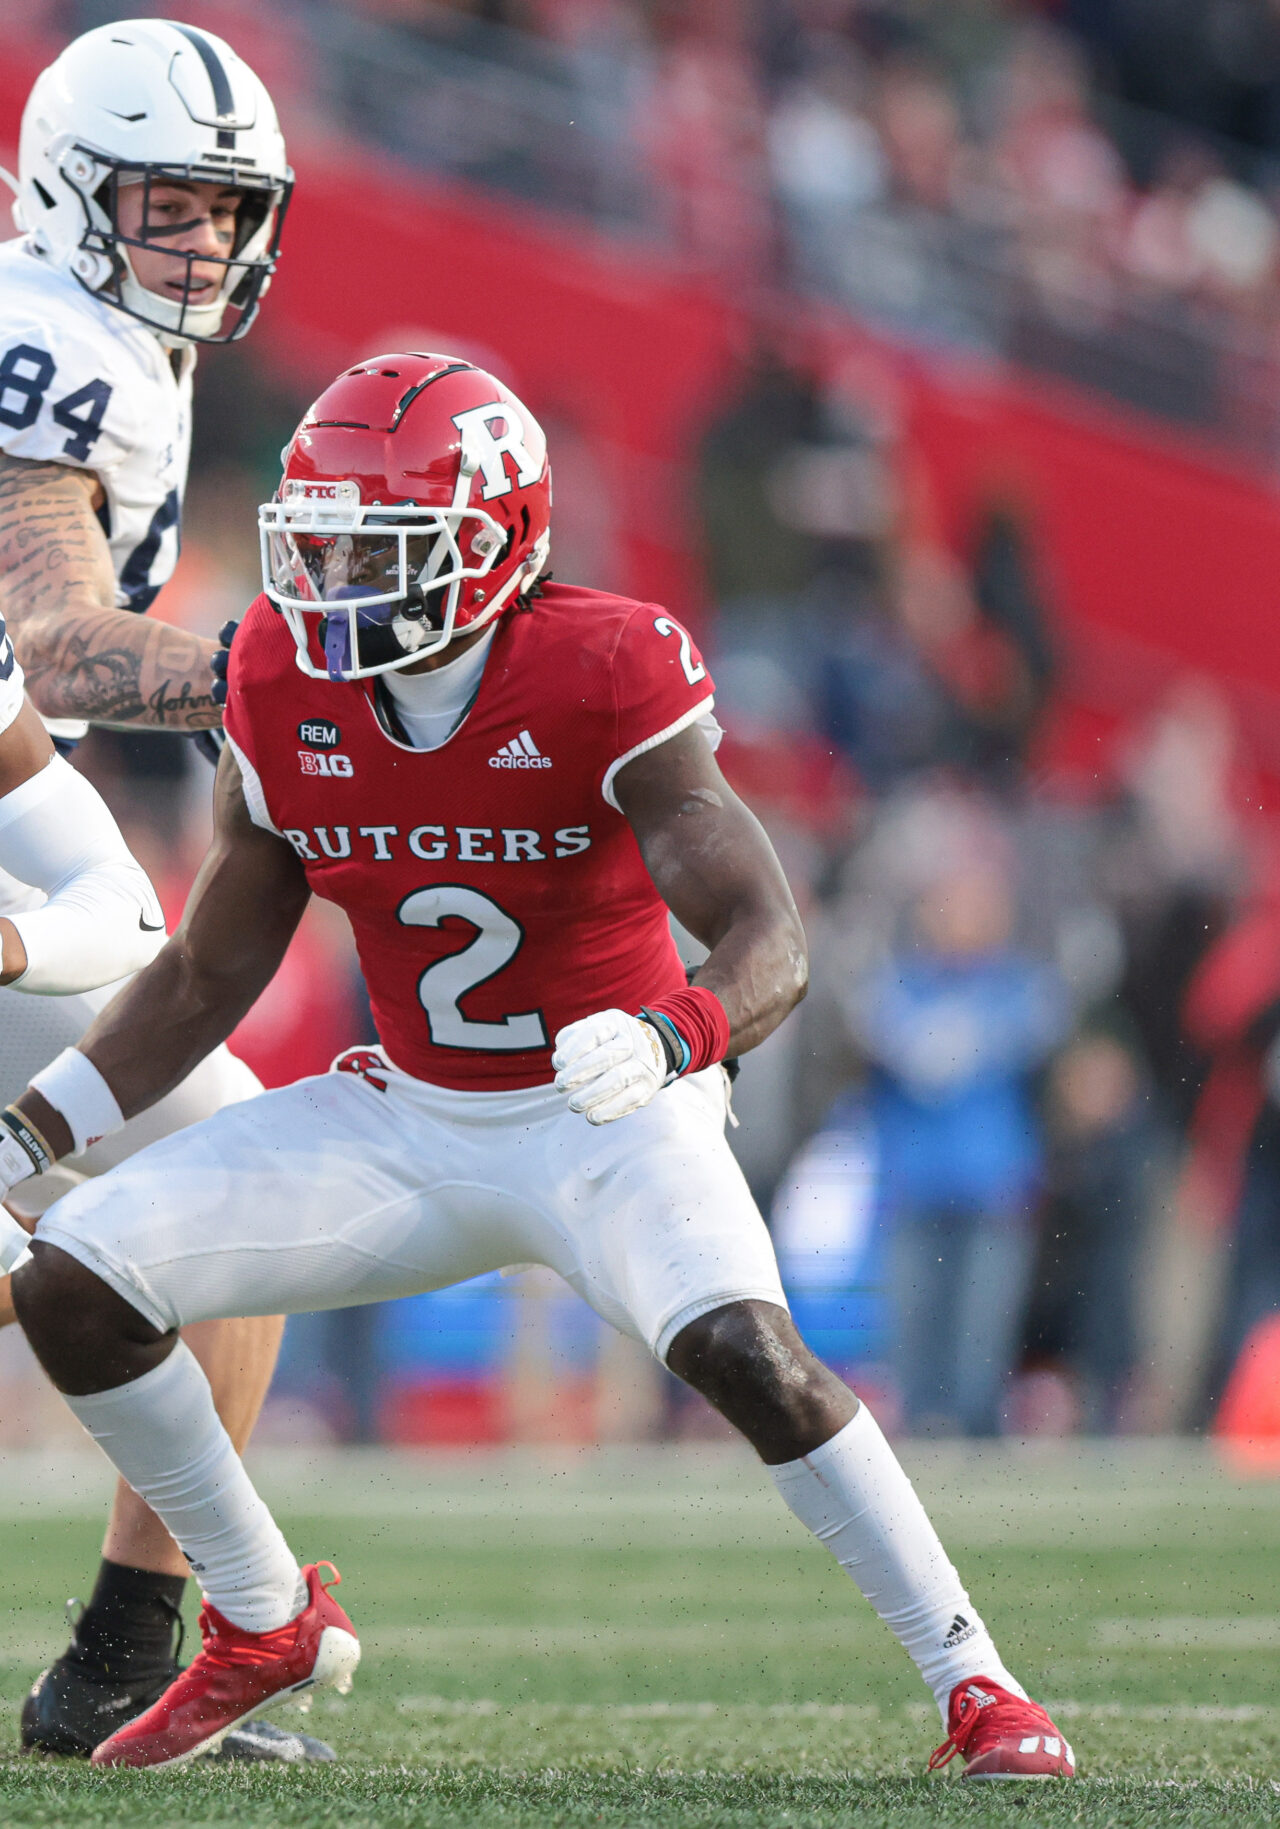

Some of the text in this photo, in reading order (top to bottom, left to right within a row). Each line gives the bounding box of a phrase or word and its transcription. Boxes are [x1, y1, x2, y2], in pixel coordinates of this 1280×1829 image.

[451, 401, 542, 501] R
[653, 616, 707, 686] 2
[300, 724, 337, 745] REM
[488, 754, 553, 769] adidas
[283, 824, 592, 862] RUTGERS
[395, 882, 551, 1052] 2
[943, 1625, 978, 1649] adidas
